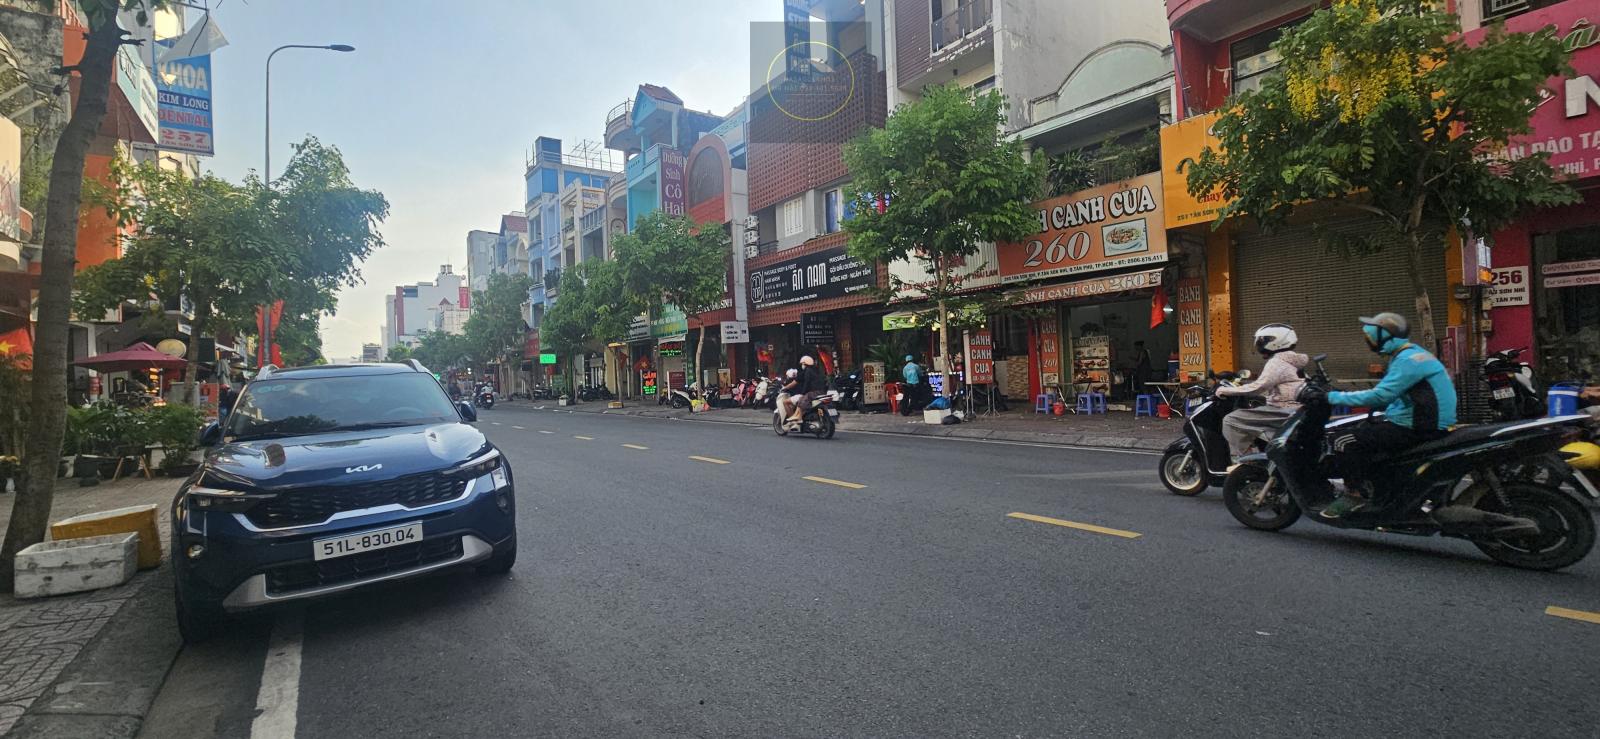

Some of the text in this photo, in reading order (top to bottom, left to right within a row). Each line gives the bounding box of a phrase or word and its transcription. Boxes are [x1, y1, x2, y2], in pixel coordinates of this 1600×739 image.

[158, 92, 209, 110] KIM LONG
[157, 108, 209, 127] DENTAL
[162, 129, 207, 144] 257
[665, 183, 682, 199] Cô
[664, 201, 685, 216] Hai
[1051, 196, 1106, 230] CANH
[1108, 185, 1157, 218] CUA
[1023, 230, 1092, 268] 260
[807, 262, 827, 288] NAM
[1490, 270, 1523, 286] 256
[1047, 286, 1079, 299] CANH
[1082, 283, 1106, 293] CUA
[1108, 274, 1146, 290] 260
[1179, 281, 1201, 303] BÁNH
[1180, 308, 1202, 325] CANH
[1043, 339, 1056, 353] CUA
[1183, 331, 1200, 348] CUA
[971, 348, 992, 360] CANH
[1183, 353, 1204, 365] 260
[974, 362, 990, 374] CUA
[345, 463, 383, 474] KIA
[323, 527, 415, 556] 51L-830.04
